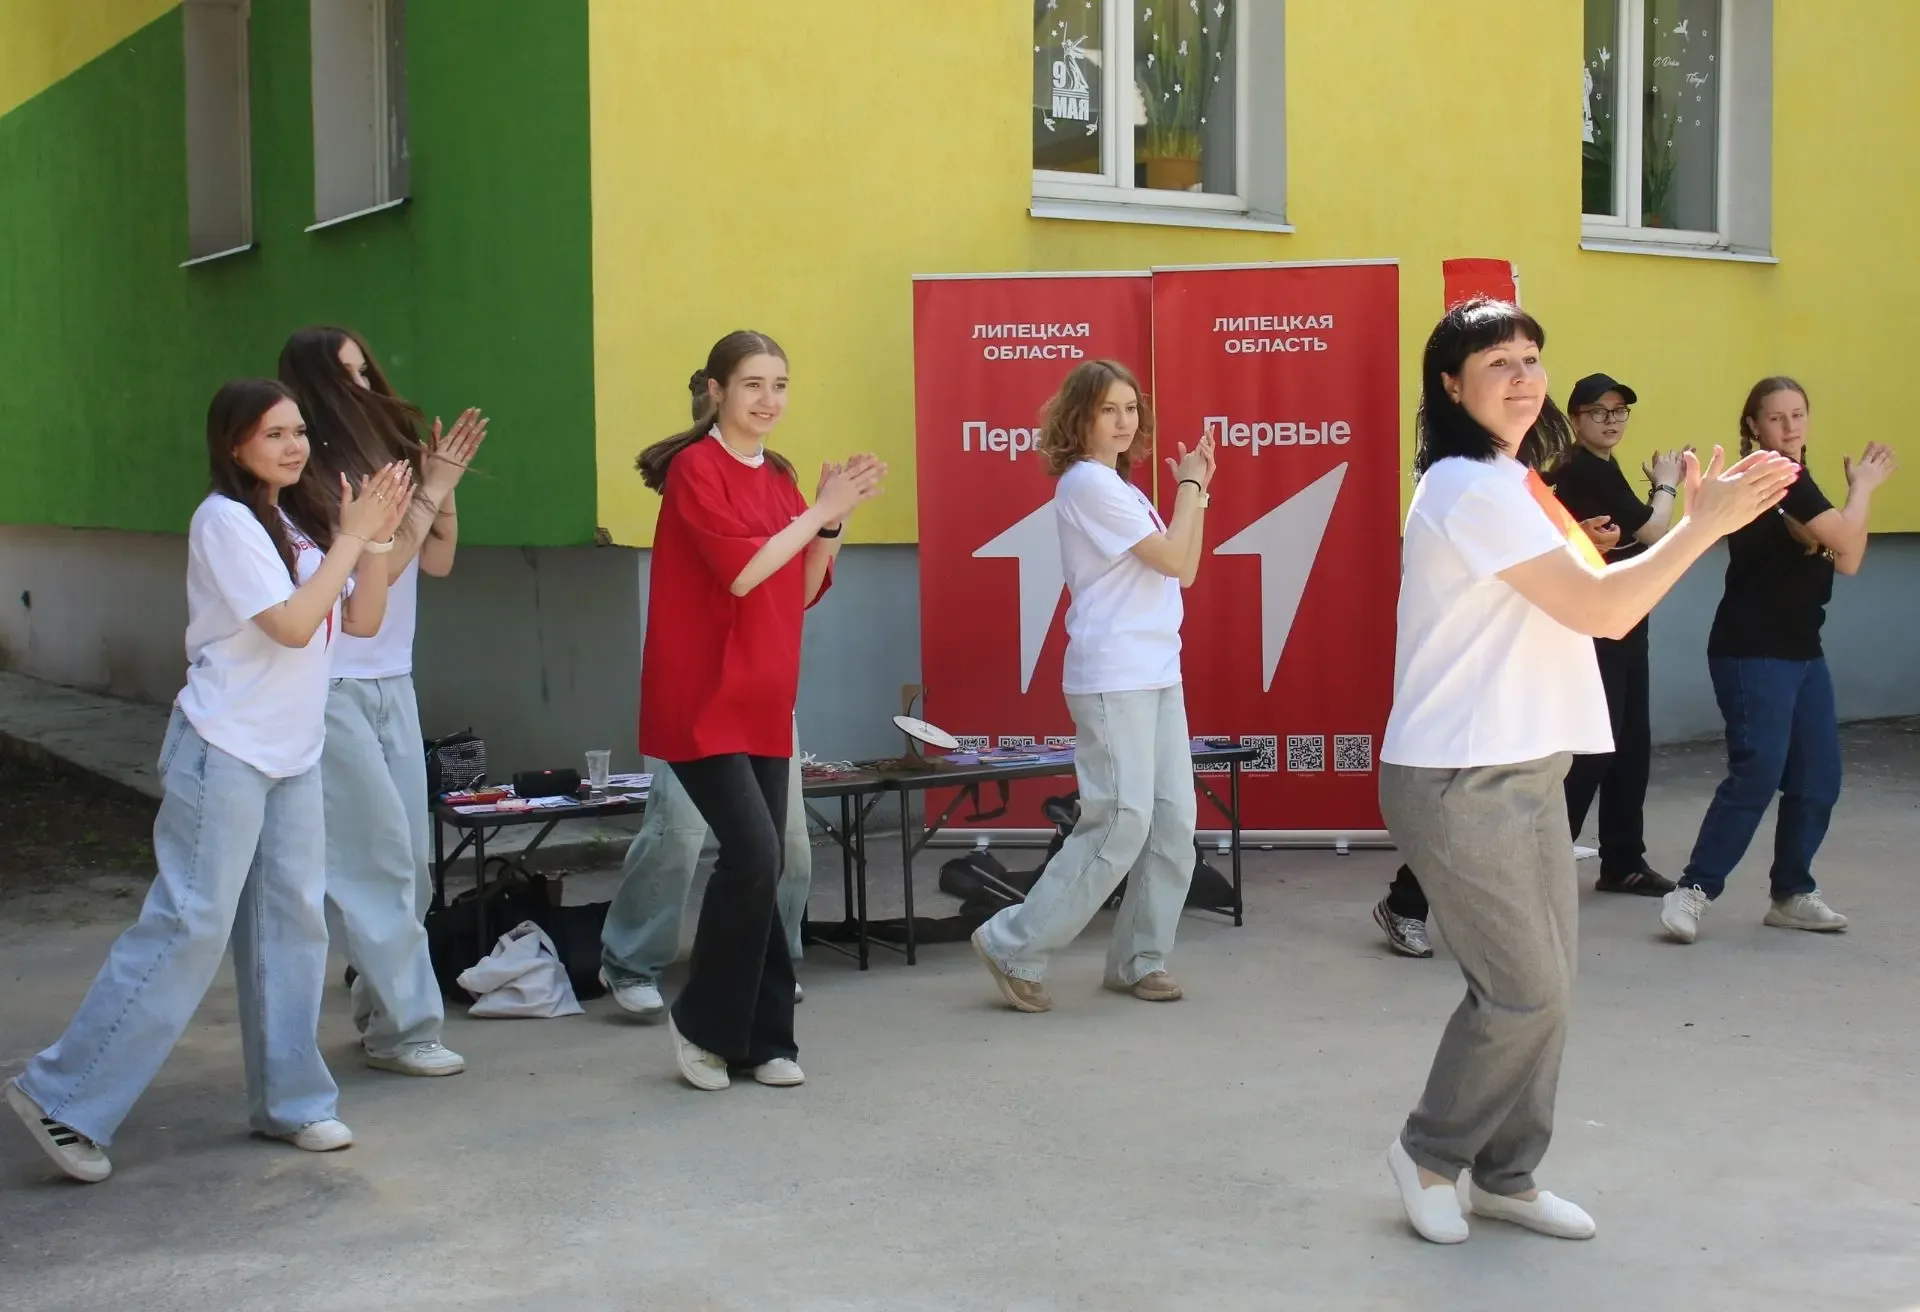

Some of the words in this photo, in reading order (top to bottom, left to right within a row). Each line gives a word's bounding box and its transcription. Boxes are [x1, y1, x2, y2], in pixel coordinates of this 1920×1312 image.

[1053, 61, 1066, 88] 9
[1053, 96, 1089, 121] МАЯ
[972, 323, 1090, 340] ЛИПЕЦКАЯ
[1213, 315, 1333, 332] ЛИПЕЦКАЯ
[983, 345, 1084, 360] ОБЛАСТЬ
[1224, 337, 1328, 353] ОБЛАСТЬ
[1203, 416, 1351, 456] Первые
